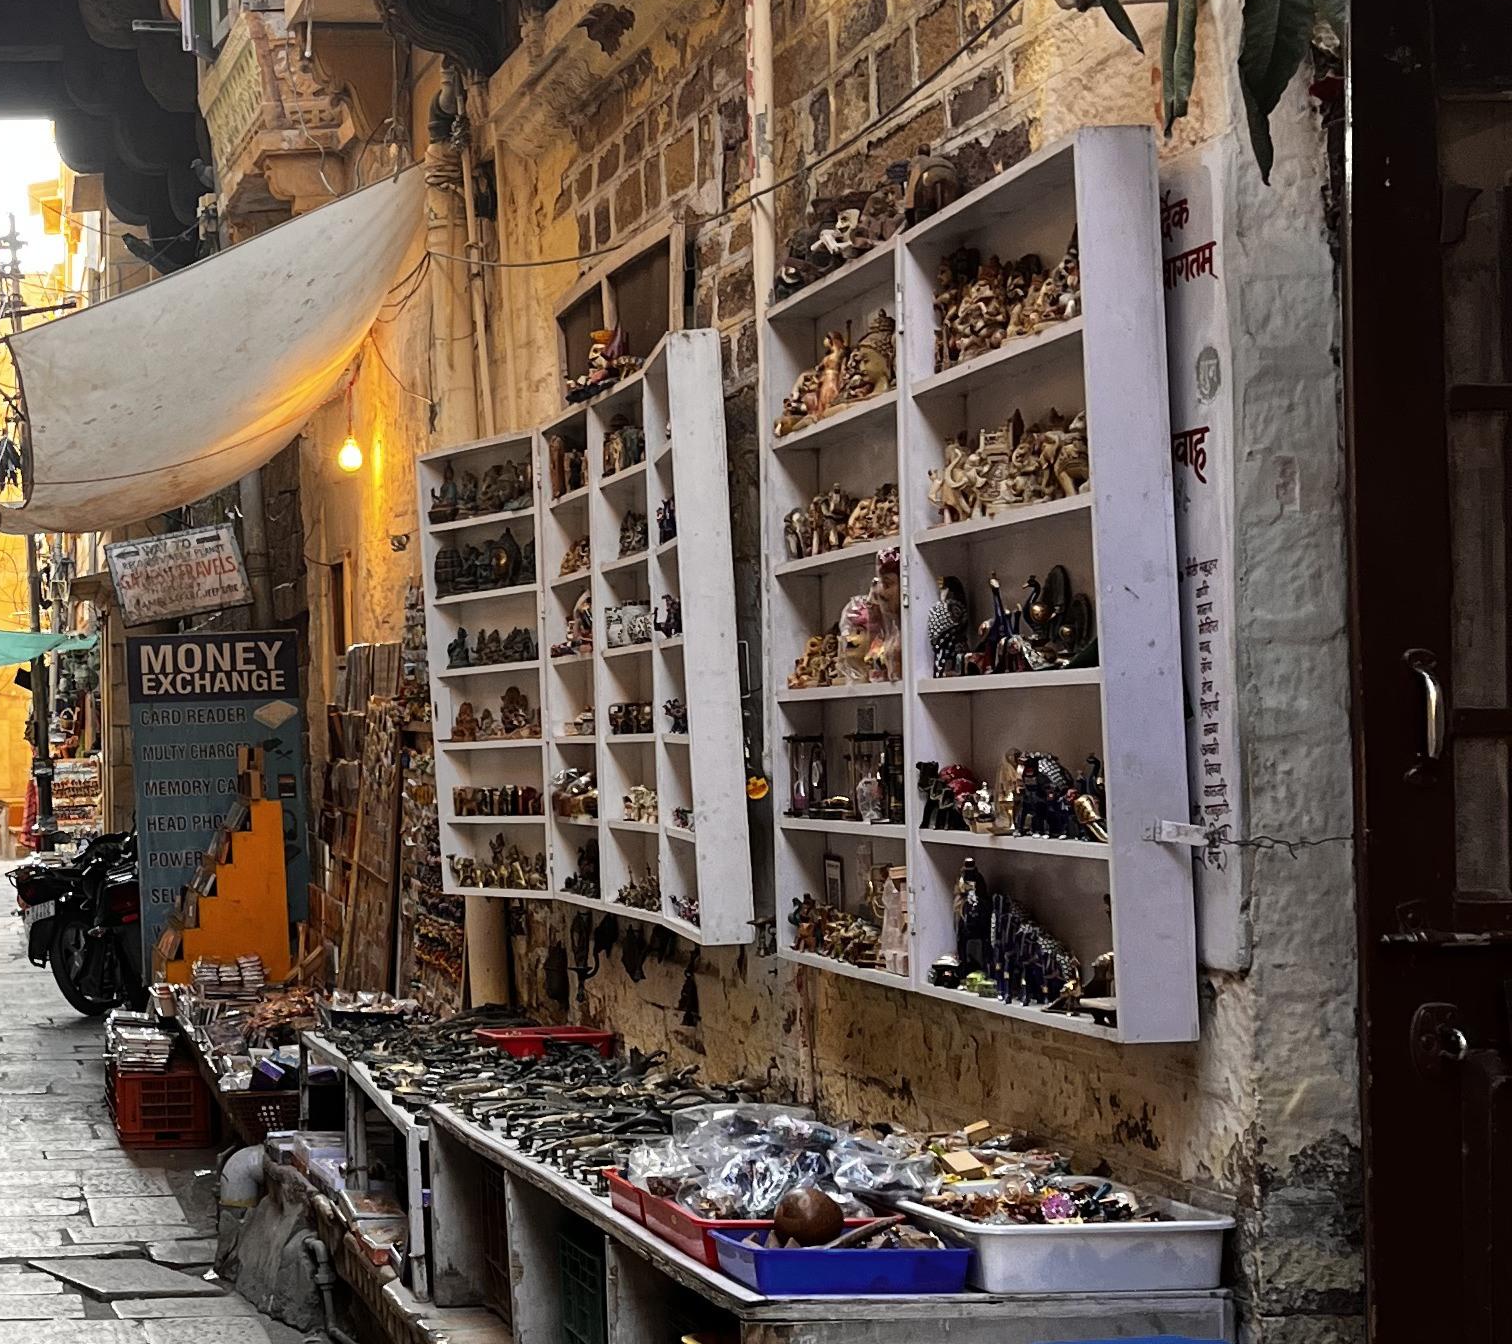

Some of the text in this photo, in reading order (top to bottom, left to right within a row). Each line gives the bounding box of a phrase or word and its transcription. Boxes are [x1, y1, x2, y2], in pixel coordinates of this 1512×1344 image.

[140, 641, 283, 674] MONEY
[142, 670, 286, 695] EXCHANGE
[141, 707, 247, 725] CARD READER
[143, 742, 251, 761] MULTY CHARG
[145, 778, 211, 797] MEMORY
[147, 813, 228, 832] HEAD PHO
[149, 850, 203, 868] POWER
